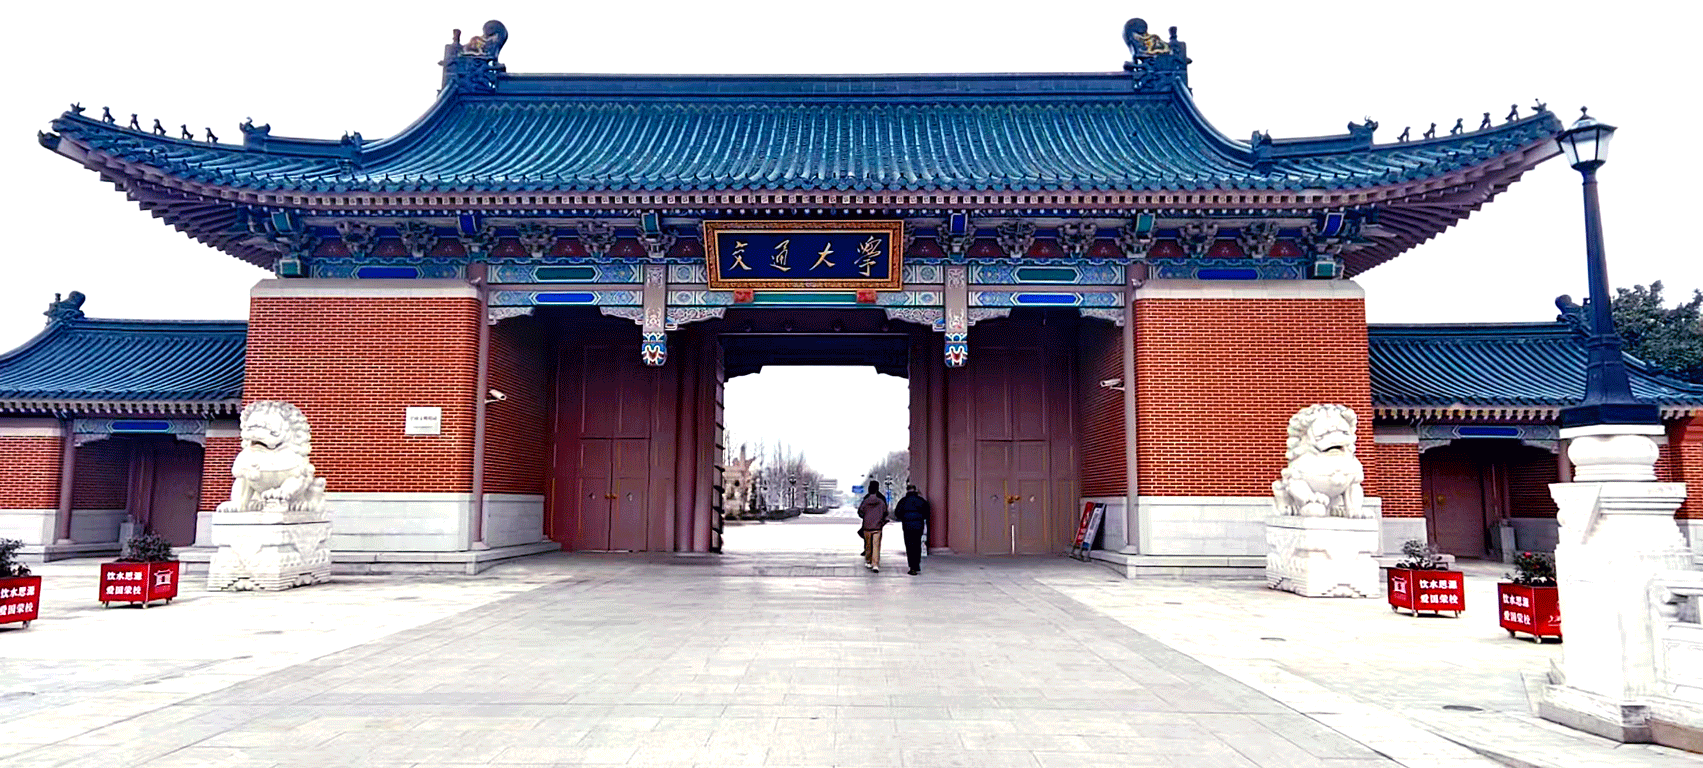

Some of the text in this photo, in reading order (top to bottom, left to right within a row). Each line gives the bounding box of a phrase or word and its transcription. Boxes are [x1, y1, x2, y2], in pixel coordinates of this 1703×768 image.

[728, 235, 882, 277] 交通大學
[106, 571, 143, 581] 饮水思源
[105, 585, 142, 595] 爱国荣校
[1419, 579, 1458, 590] 饮水思源
[1420, 594, 1459, 605] 爱国荣校
